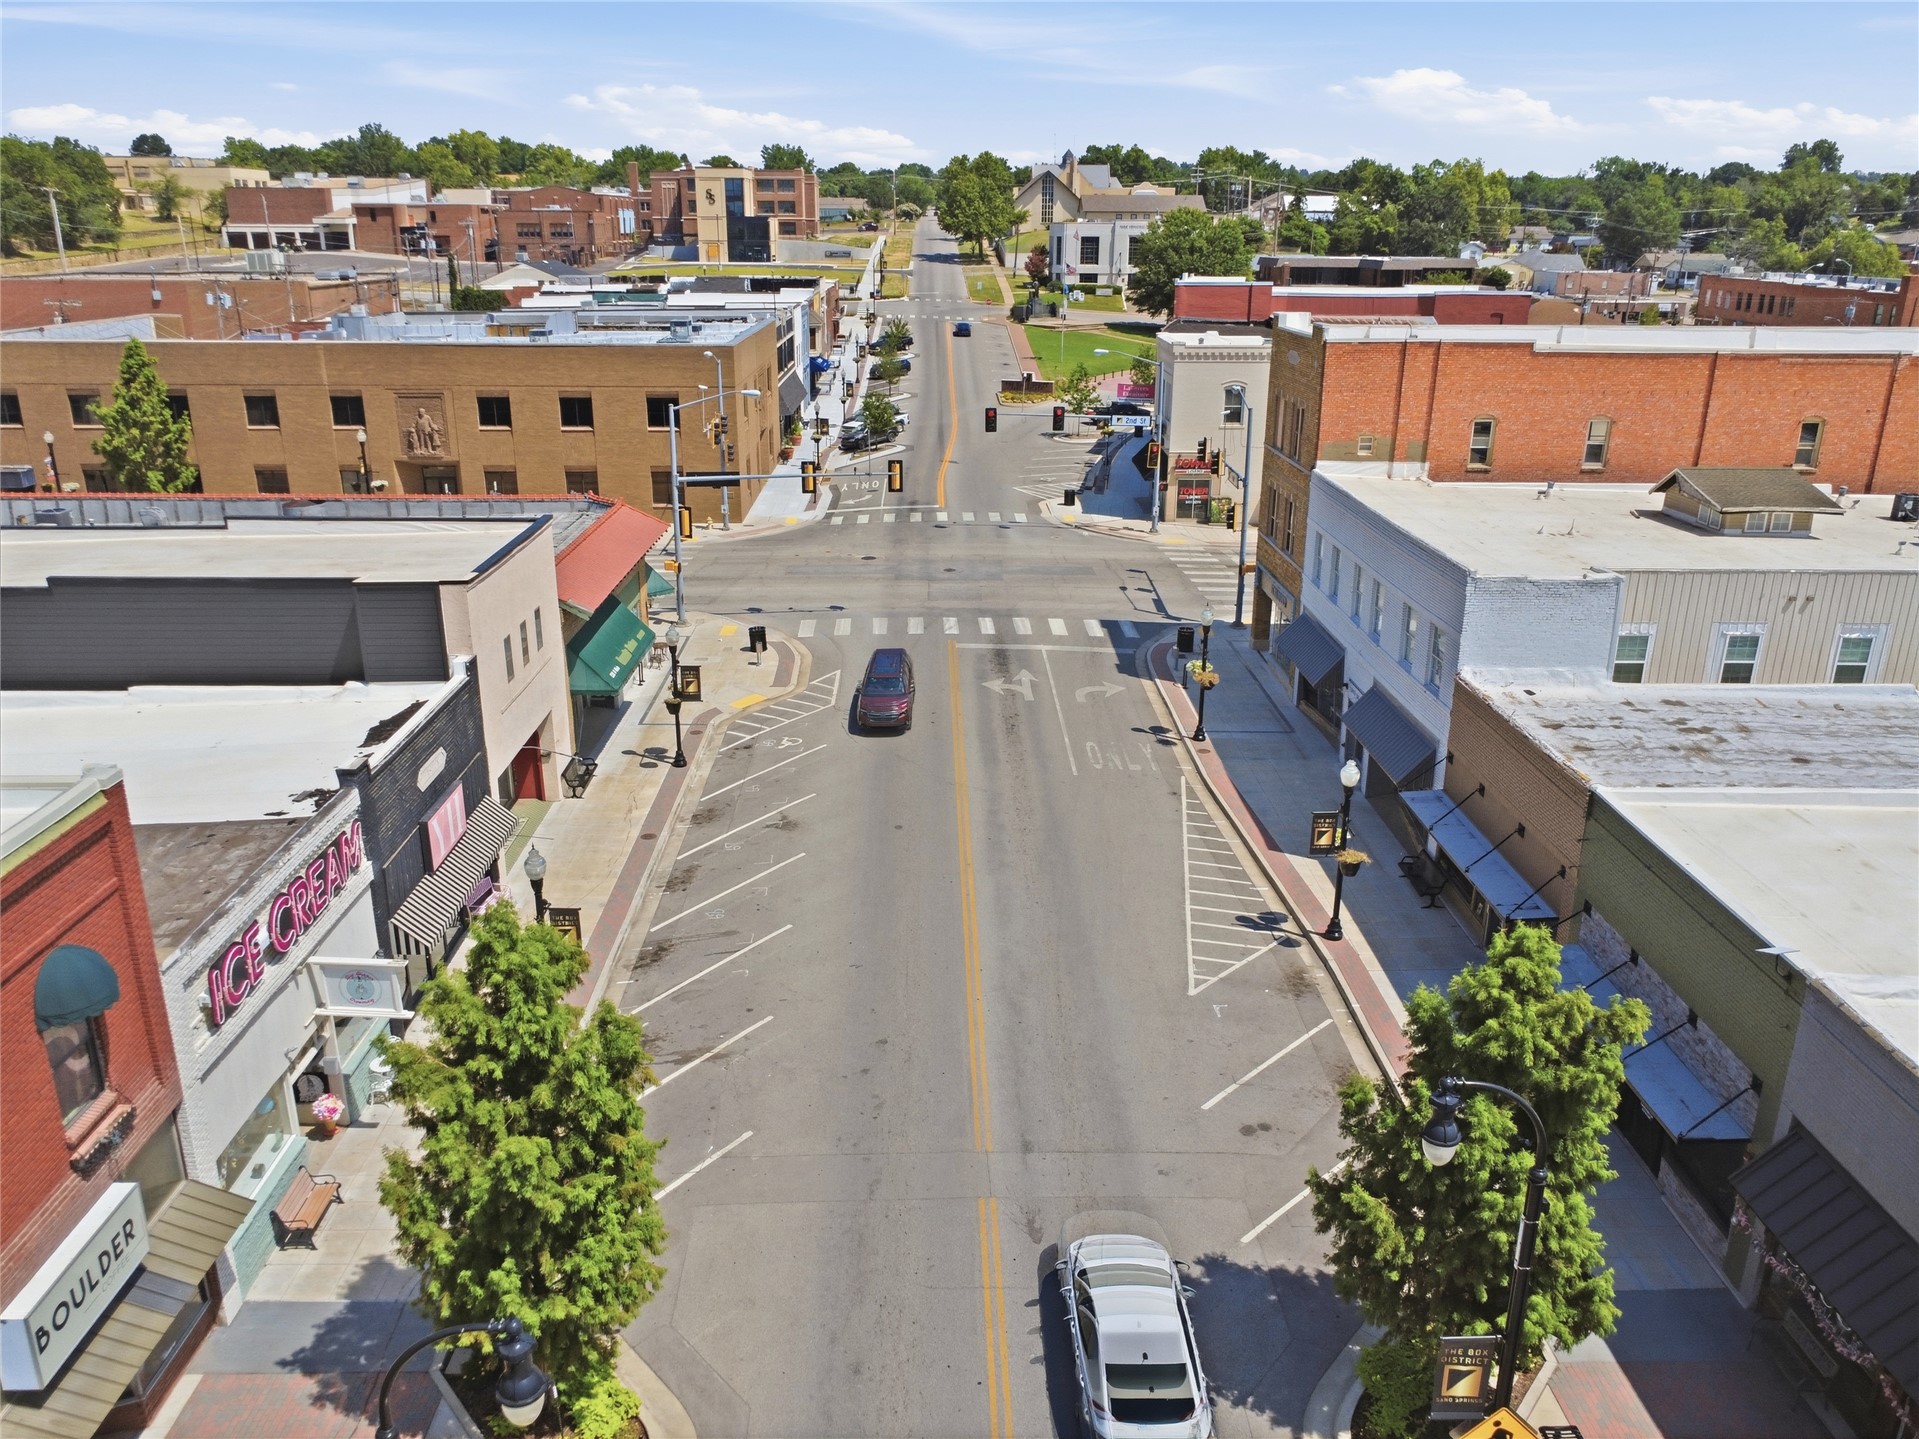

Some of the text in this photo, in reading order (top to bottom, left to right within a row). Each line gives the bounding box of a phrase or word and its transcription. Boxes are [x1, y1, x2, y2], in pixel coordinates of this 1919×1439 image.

[1140, 417, 1147, 425] St
[841, 480, 879, 492] ONLY
[1180, 486, 1209, 495] TOWER
[1085, 741, 1157, 771] ONLY
[207, 818, 363, 1027] ICE CREAM
[101, 1255, 131, 1293] COFFEE
[35, 1218, 136, 1355] BOULDER
[1445, 1348, 1489, 1356] THE BOX
[1441, 1356, 1489, 1365] DISTRICT
